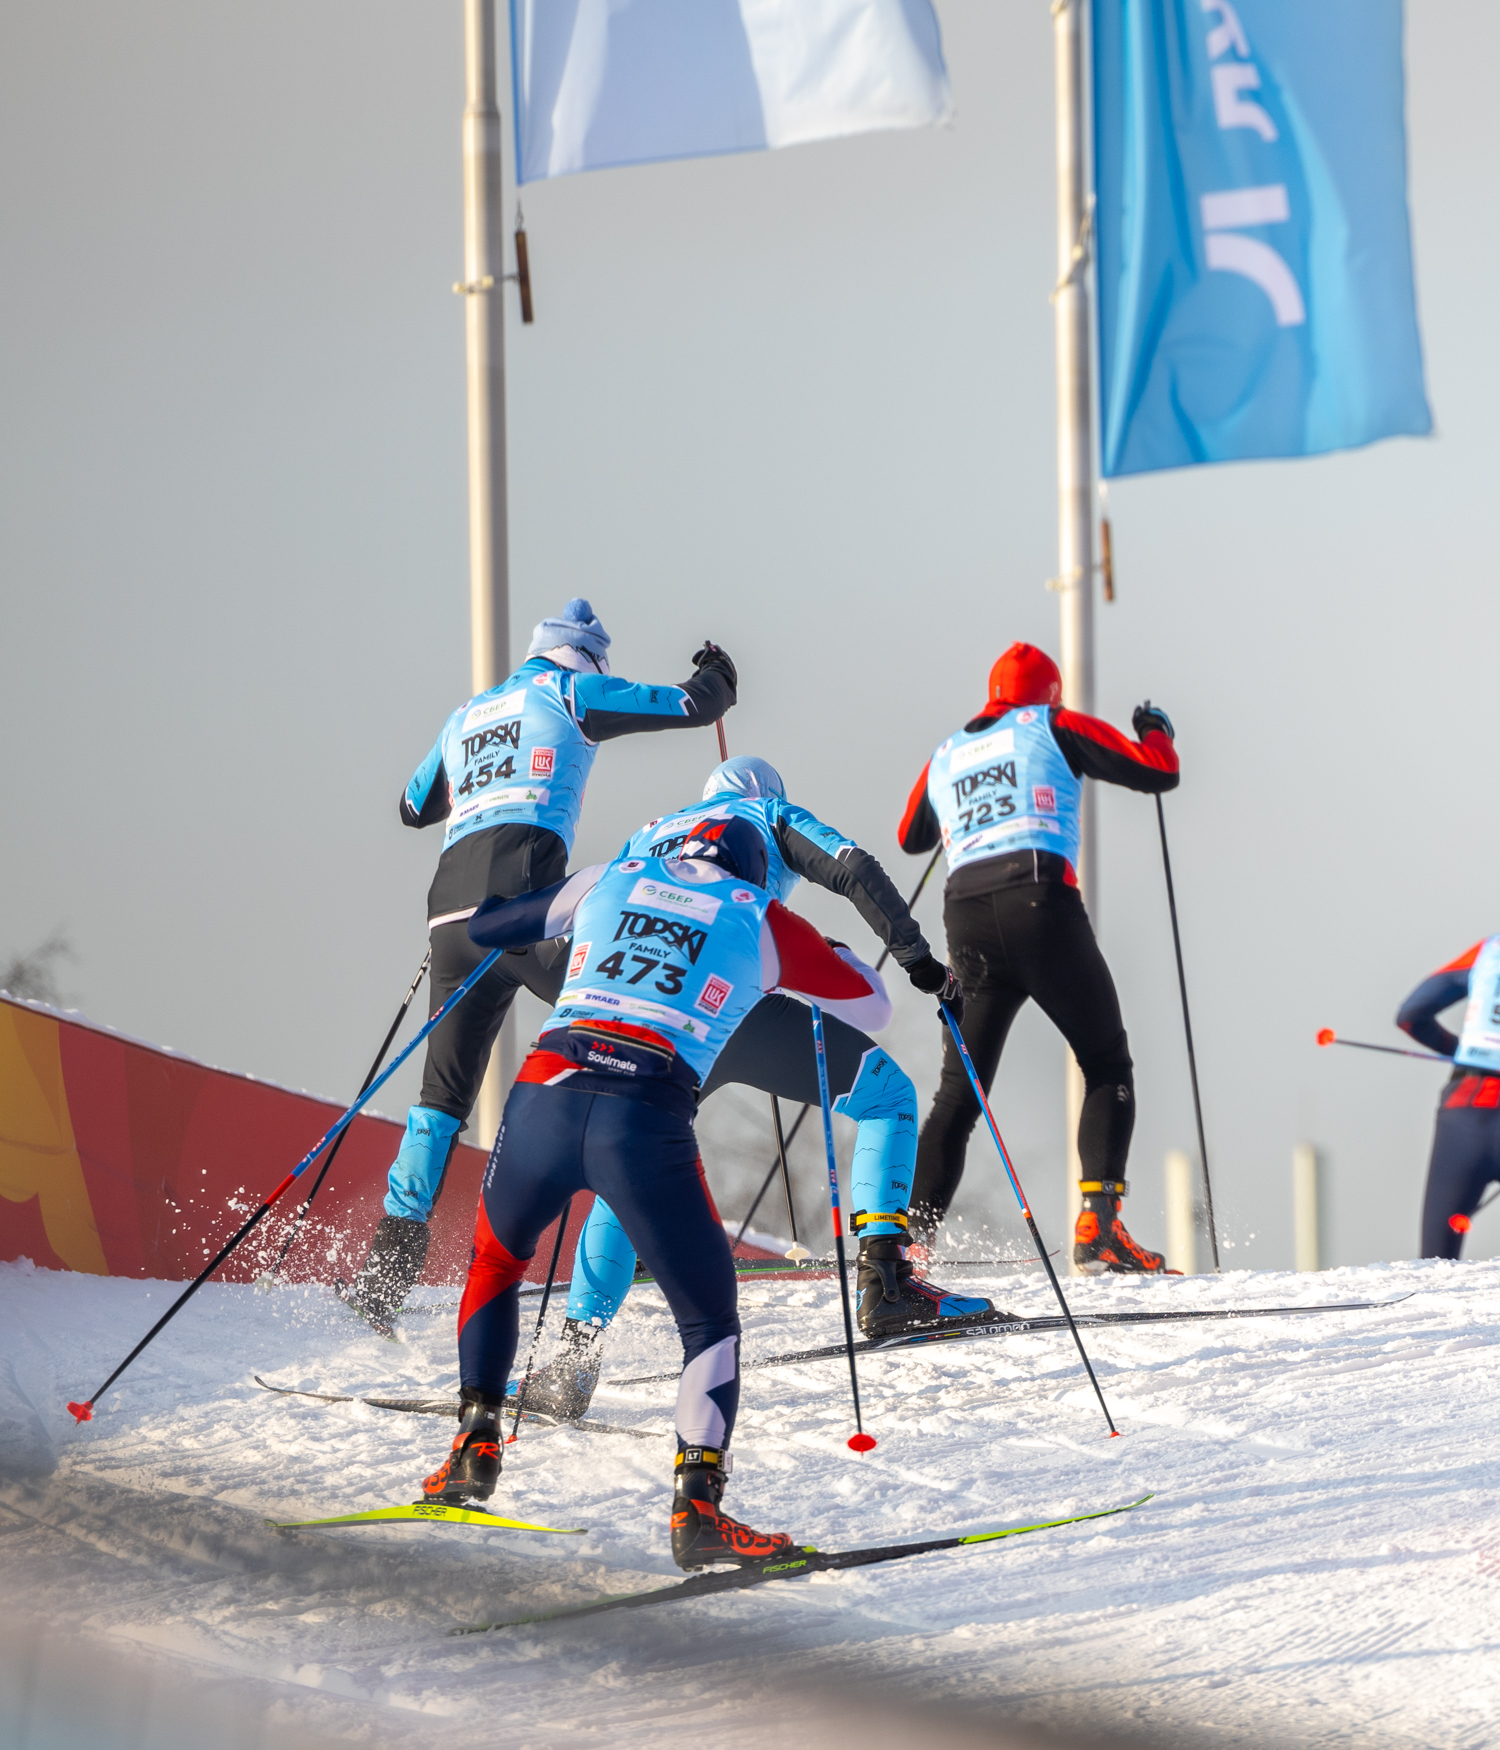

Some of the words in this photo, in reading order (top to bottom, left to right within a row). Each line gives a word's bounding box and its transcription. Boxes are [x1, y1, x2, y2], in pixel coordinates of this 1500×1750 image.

[483, 701, 507, 715] СБЕР
[461, 719, 521, 769] TOPSKI
[474, 750, 500, 766] FAMILY
[458, 755, 516, 796] 454
[952, 760, 1017, 809] TOPSKI
[968, 789, 998, 805] FAMILY
[676, 814, 706, 827] СБЕР
[958, 795, 1016, 832] 723
[659, 890, 693, 904] СБЕР
[612, 910, 707, 966] TOPSKI
[629, 942, 671, 959] FAMILY
[596, 951, 688, 996] 473
[591, 995, 620, 1006] MAER
[587, 1050, 637, 1072] Soulmate
[487, 1155, 498, 1188] SPORT
[496, 1125, 505, 1153] CLUB
[874, 1214, 900, 1222] LIMETIME
[688, 1452, 698, 1460] LT
[413, 1505, 447, 1516] FISCHER
[762, 1560, 807, 1574] FISCHER
